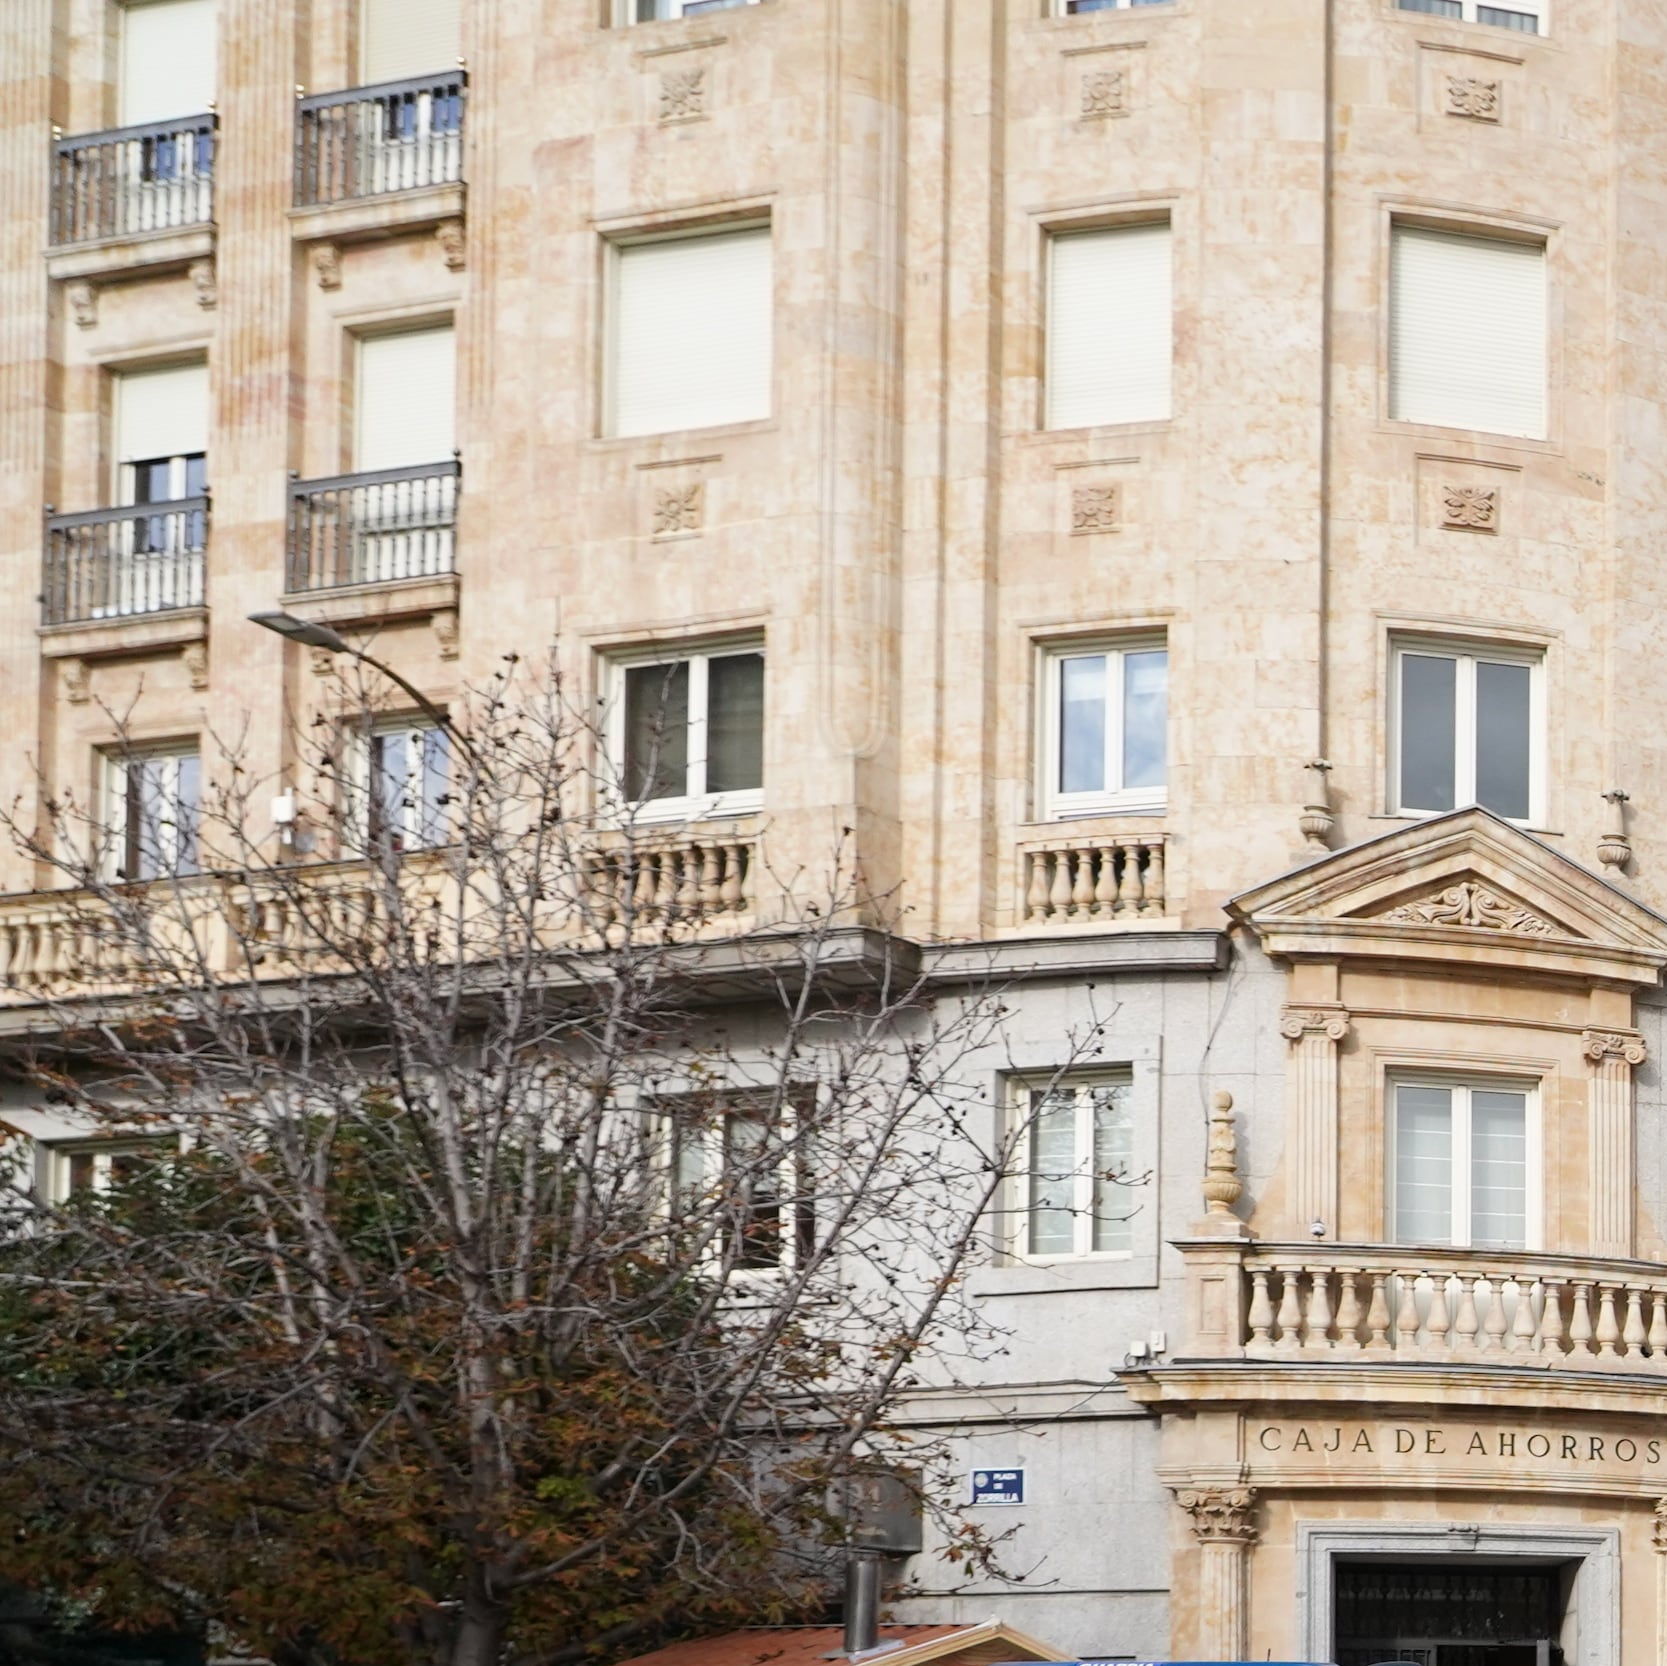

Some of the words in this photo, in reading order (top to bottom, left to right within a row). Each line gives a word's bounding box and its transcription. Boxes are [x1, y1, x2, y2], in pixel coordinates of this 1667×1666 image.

[1259, 1427, 1374, 1454] CAJA
[1396, 1429, 1447, 1455] DE
[1466, 1431, 1662, 1464] AHORROS
